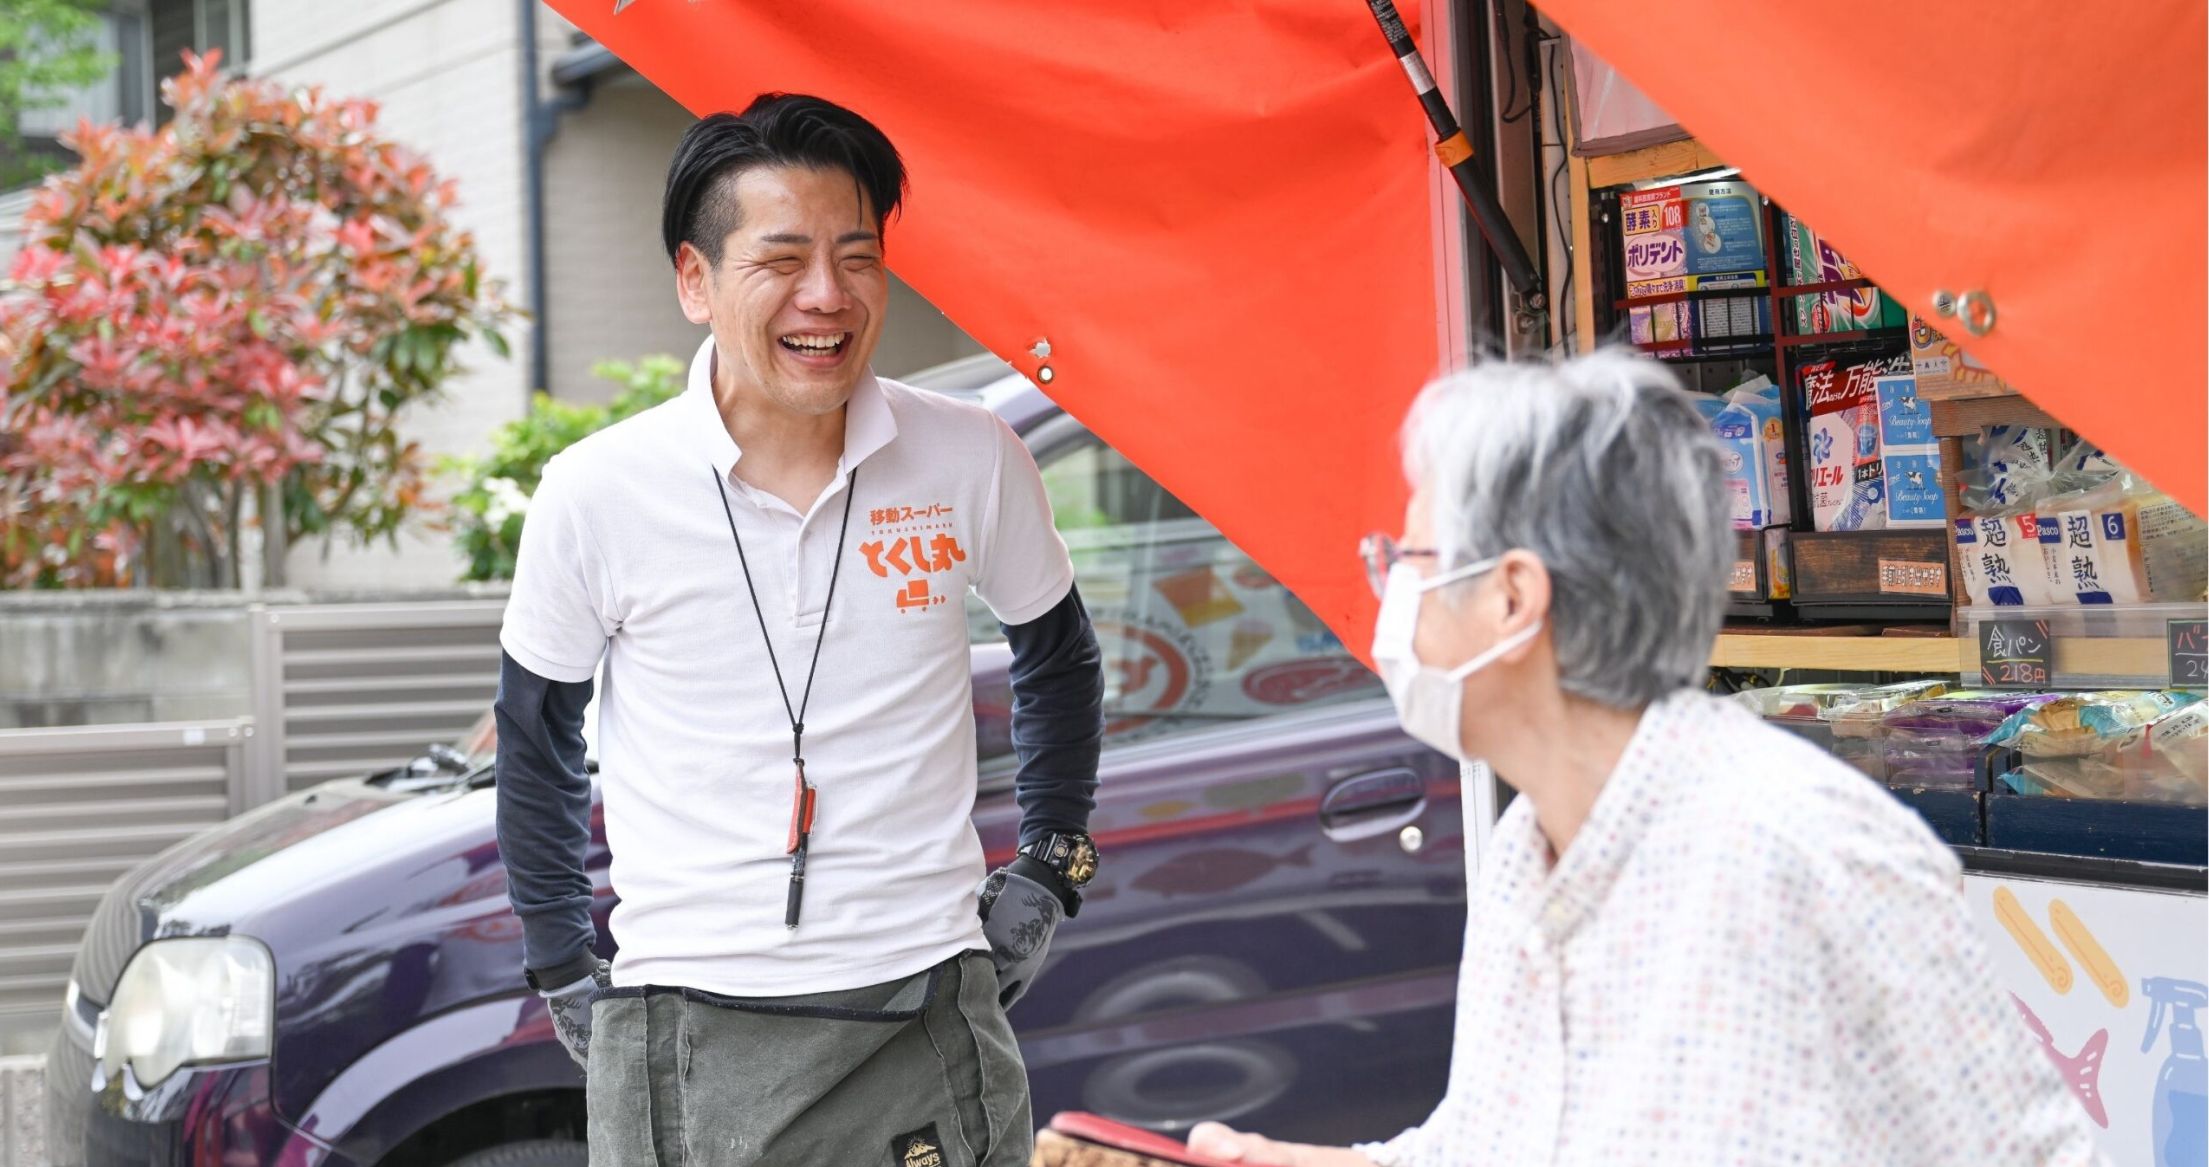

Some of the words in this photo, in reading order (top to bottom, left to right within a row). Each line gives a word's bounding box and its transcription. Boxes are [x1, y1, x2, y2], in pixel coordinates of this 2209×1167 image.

[1627, 240, 1684, 268] ポリデント
[1810, 464, 1844, 488] リエール
[869, 502, 953, 526] 移動スーパー
[2021, 515, 2036, 533] 5
[2107, 515, 2120, 535] 6
[2037, 524, 2059, 536] Pasco
[858, 533, 967, 578] とくし丸
[1980, 518, 2013, 585] 超熟
[2067, 515, 2100, 590] 超熟
[1987, 625, 2041, 658] 食パン
[2000, 663, 2046, 684] 218円
